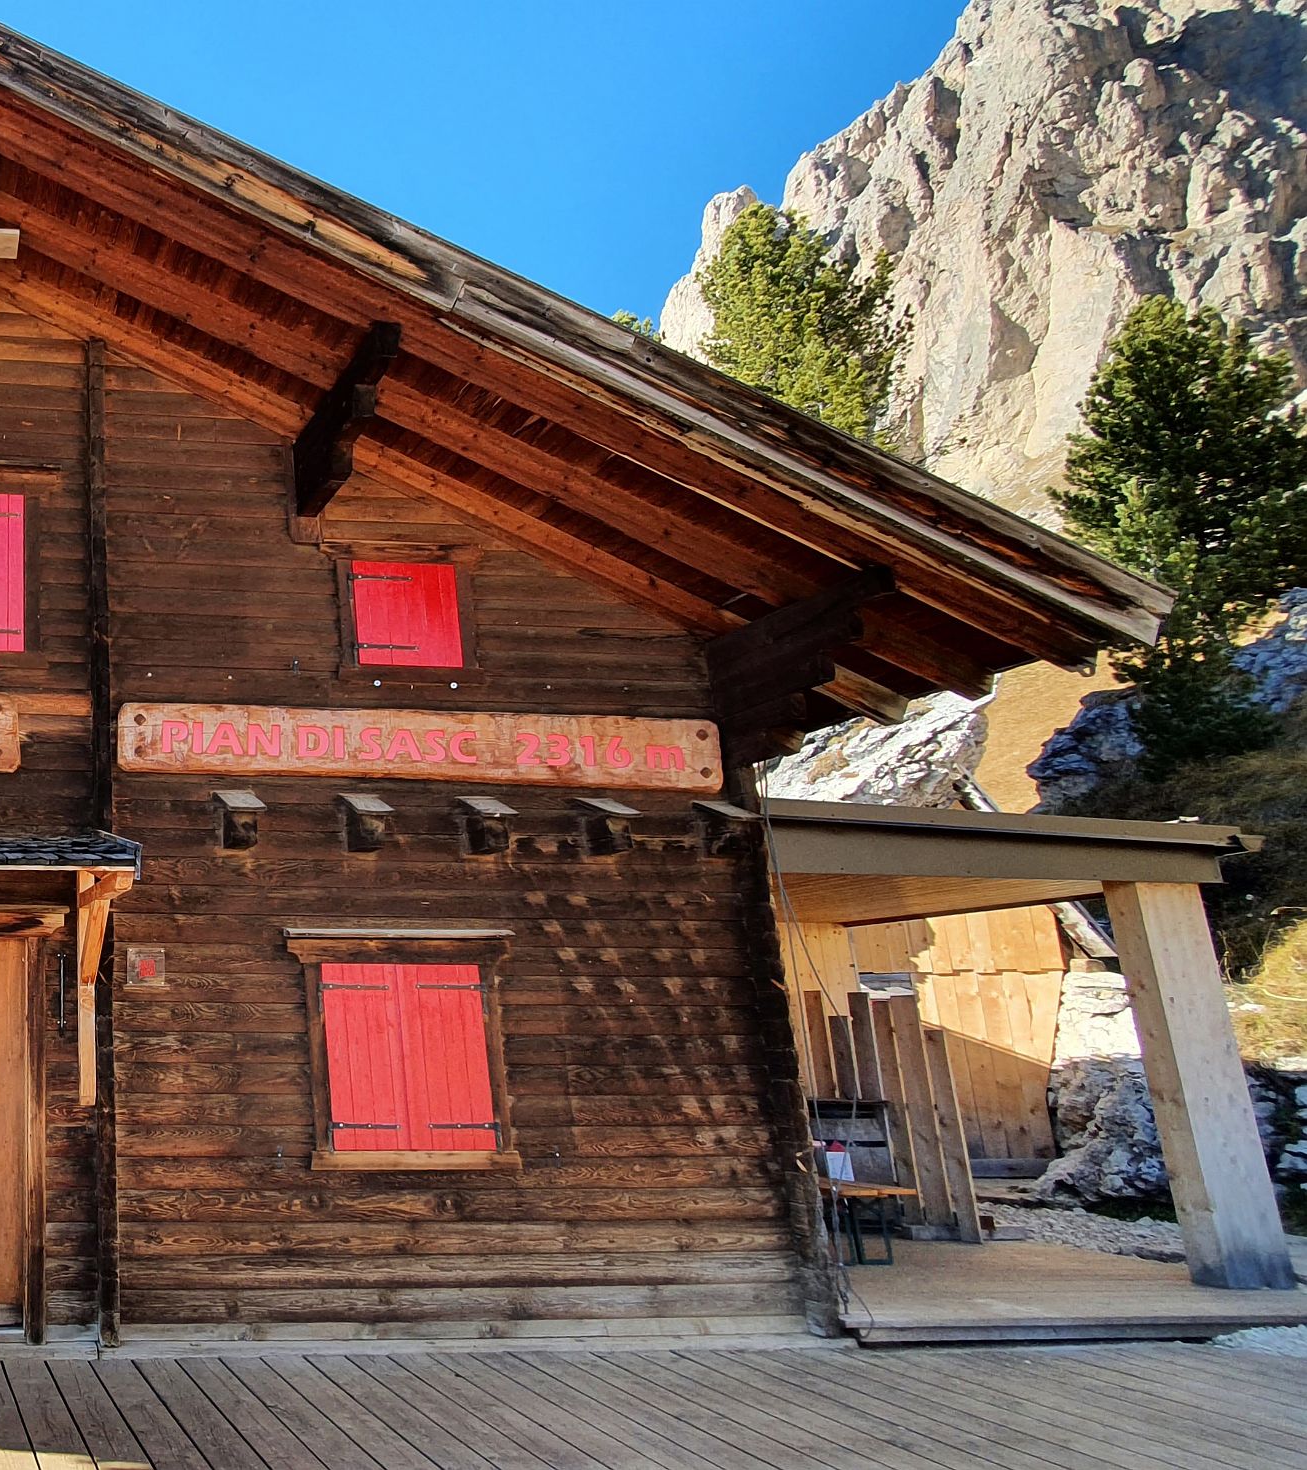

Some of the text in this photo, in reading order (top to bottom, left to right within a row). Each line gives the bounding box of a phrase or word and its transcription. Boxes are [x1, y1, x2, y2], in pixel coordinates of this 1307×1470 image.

[161, 720, 685, 771] PIAN DI SASC 2316 m
